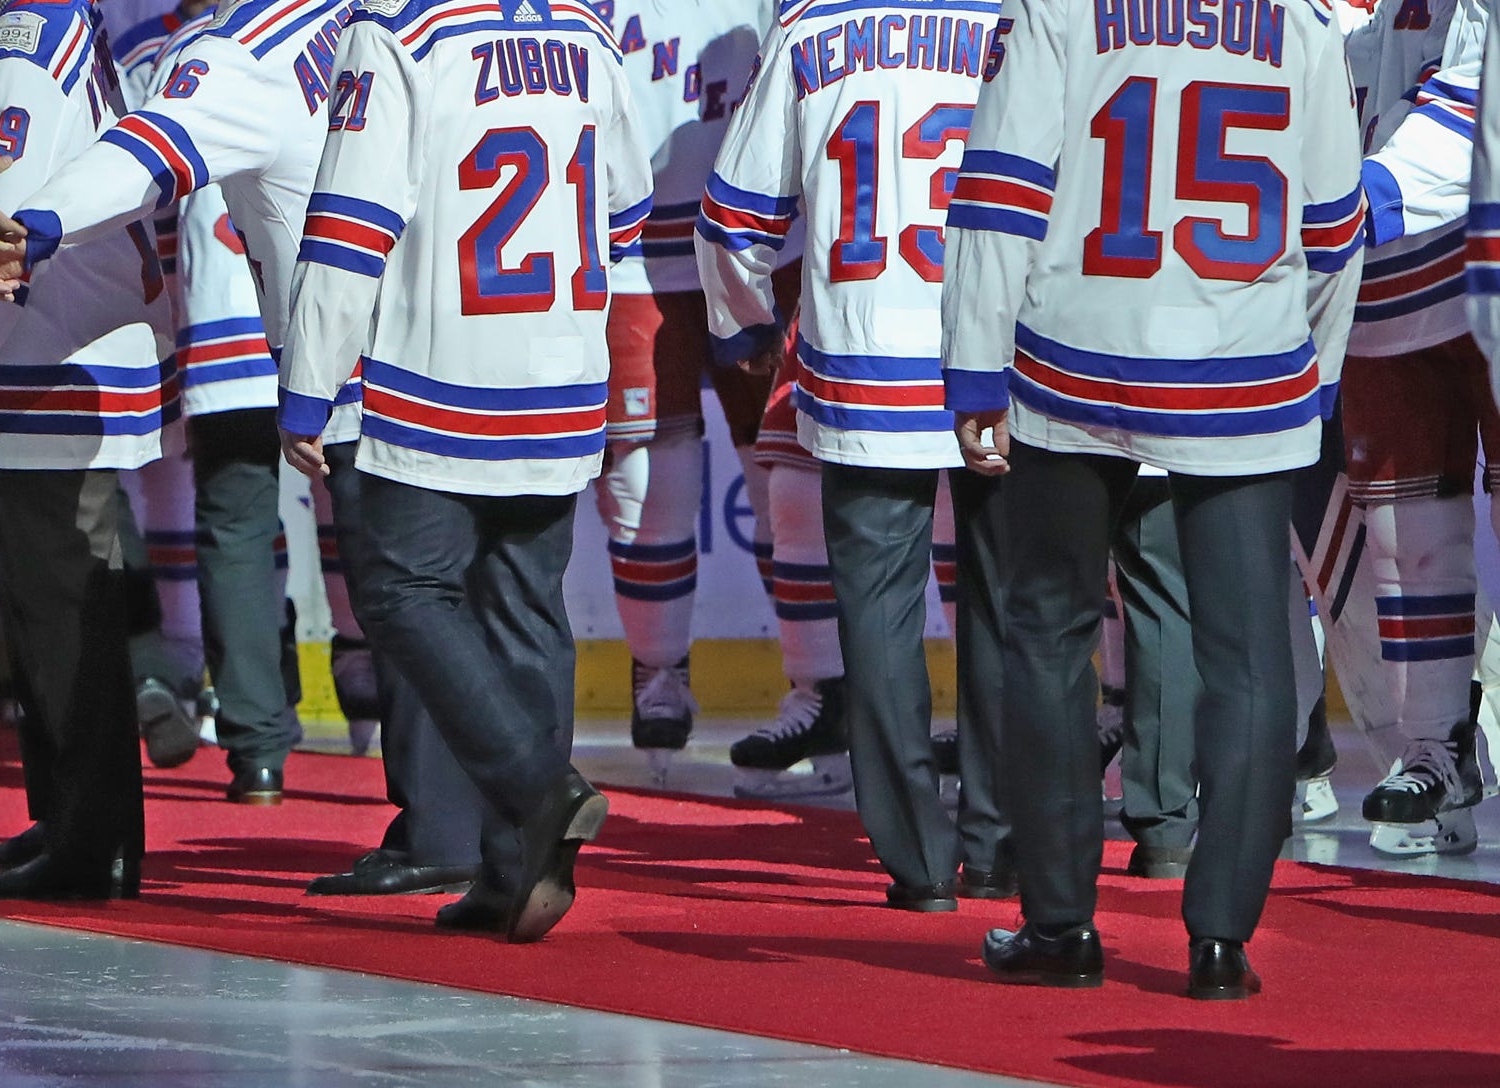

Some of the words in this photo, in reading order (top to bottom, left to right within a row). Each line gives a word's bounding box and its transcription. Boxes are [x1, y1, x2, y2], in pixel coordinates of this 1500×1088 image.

[513, 13, 543, 23] adidas
[163, 58, 210, 99] 6
[328, 70, 375, 132] 21
[471, 39, 589, 107] ZUBOV
[826, 100, 978, 283] 13
[1082, 76, 1291, 283] 15
[457, 125, 607, 316] 21
